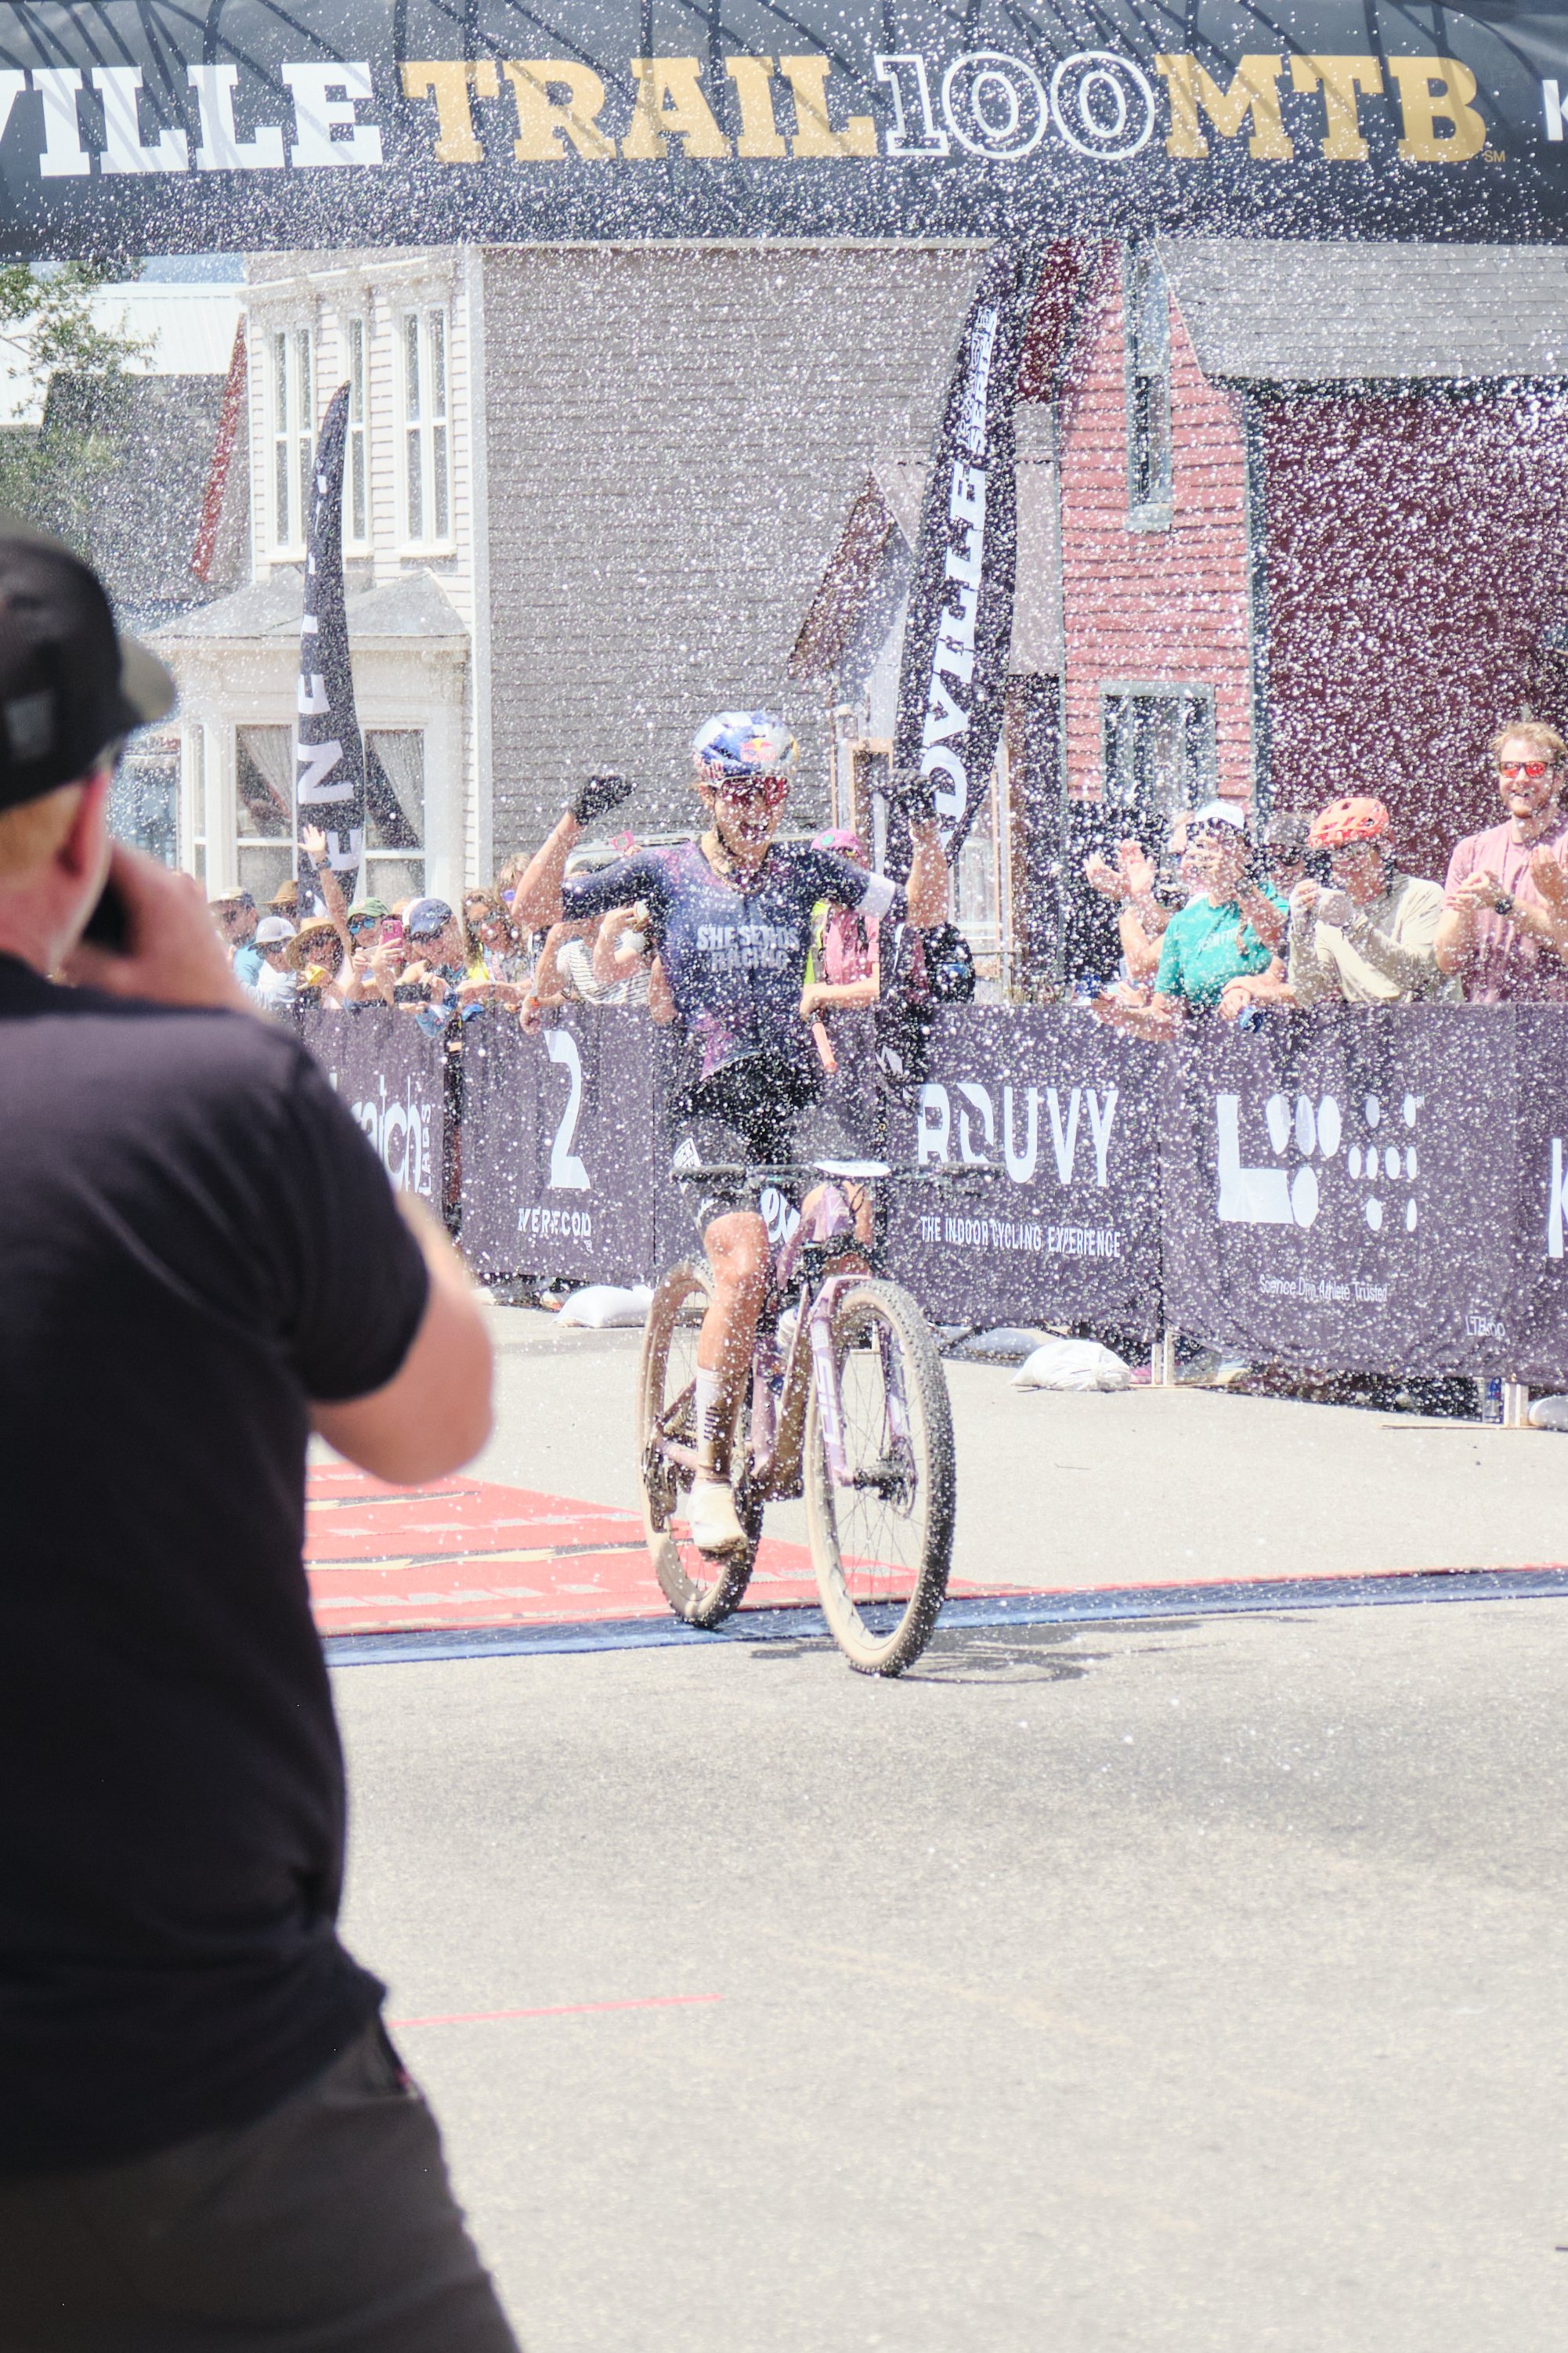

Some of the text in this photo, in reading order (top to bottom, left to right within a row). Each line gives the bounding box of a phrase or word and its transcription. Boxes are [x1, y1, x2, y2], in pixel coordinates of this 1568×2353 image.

[398, 55, 878, 162] TRAIL
[1155, 55, 1487, 163] MTB
[919, 461, 985, 846] DVILLE
[920, 1216, 941, 1243] THE
[945, 1217, 989, 1247] INDOOR
[992, 1220, 1042, 1251] CYCLING
